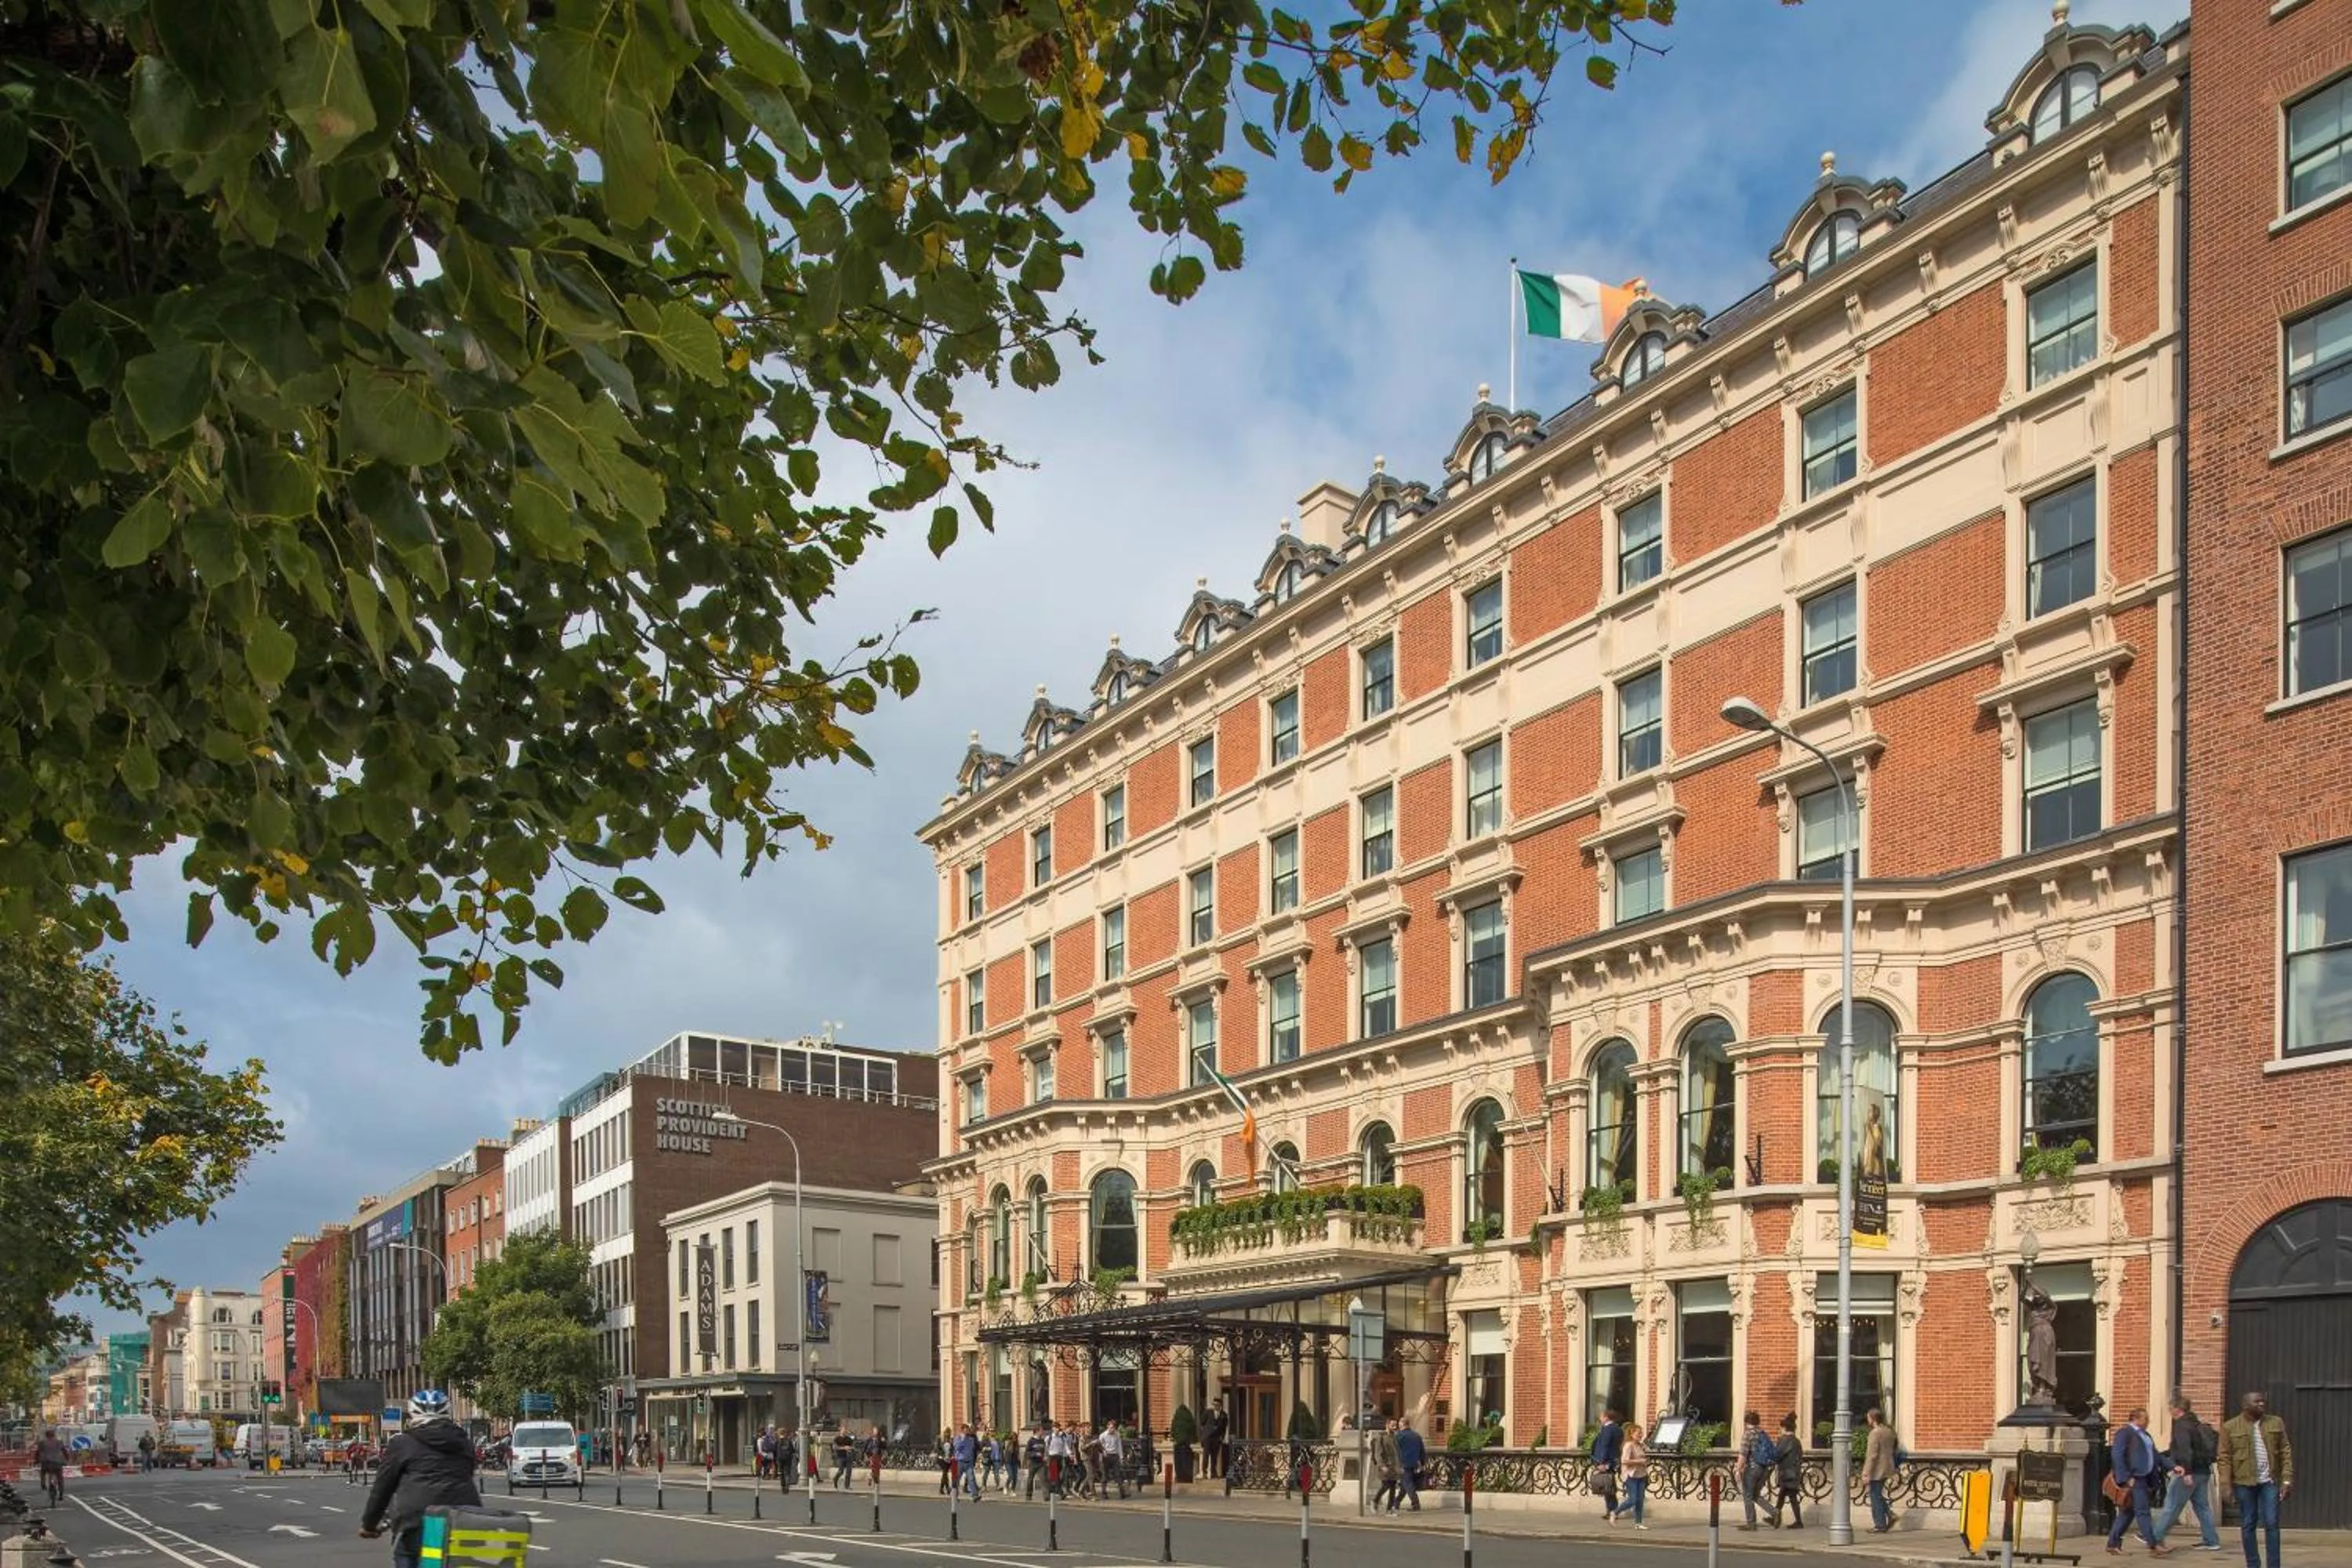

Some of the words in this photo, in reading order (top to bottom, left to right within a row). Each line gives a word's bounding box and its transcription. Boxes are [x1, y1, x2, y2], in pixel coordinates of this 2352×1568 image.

[656, 1097, 731, 1118] SCOTTISH
[656, 1115, 747, 1139] PROVIDENT
[657, 1134, 711, 1153] HOUSE
[700, 1258, 713, 1329] ADAMS
